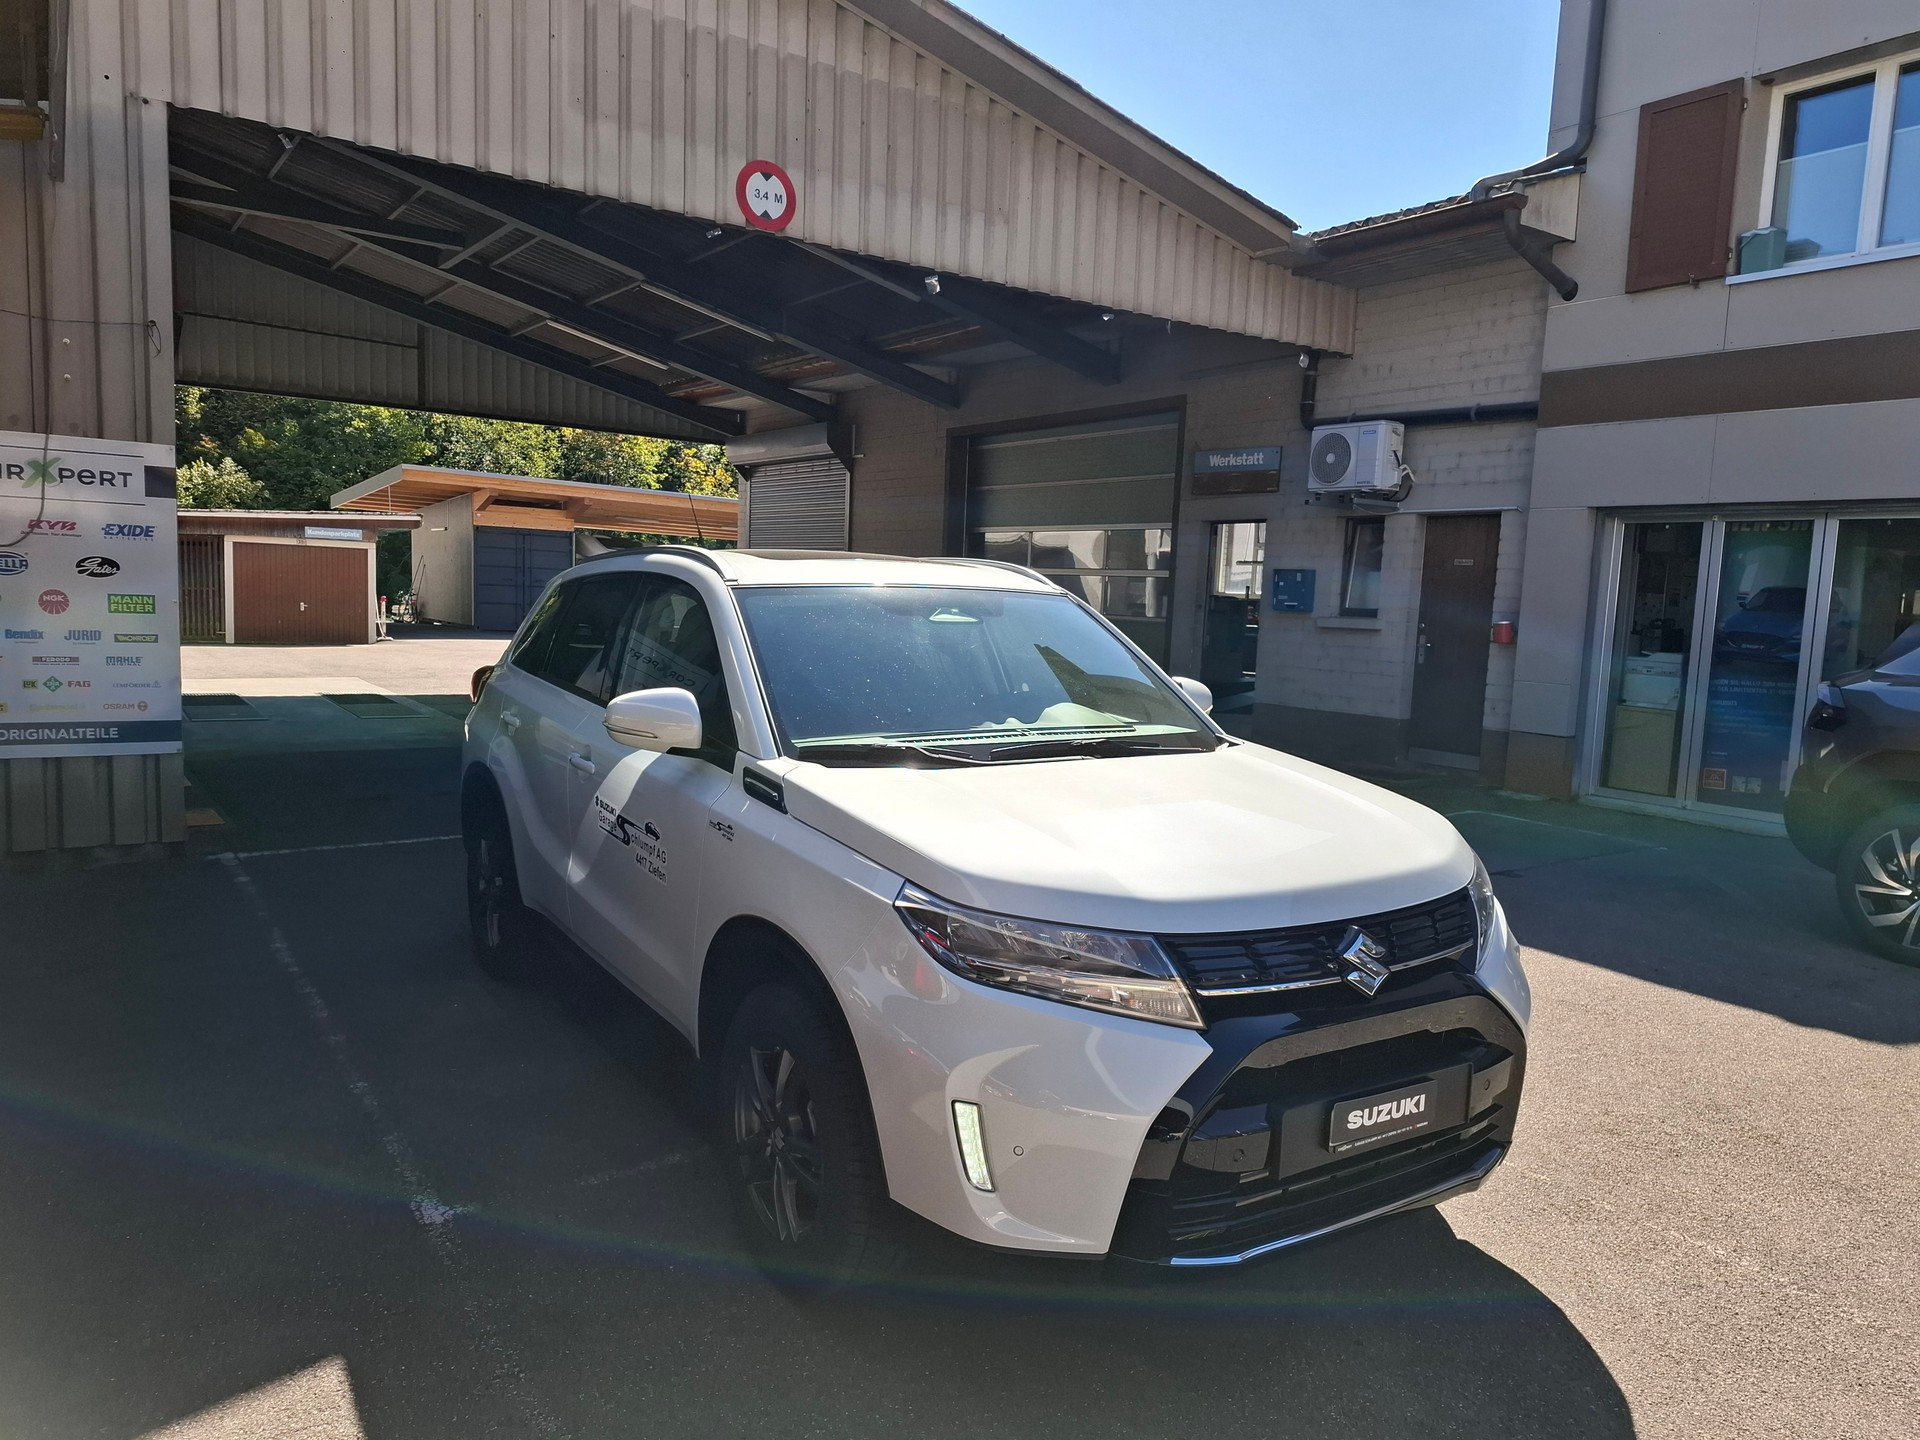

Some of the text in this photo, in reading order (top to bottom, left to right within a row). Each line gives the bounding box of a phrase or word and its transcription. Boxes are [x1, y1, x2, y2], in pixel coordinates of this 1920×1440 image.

[754, 188, 782, 204] 3,4 M
[1209, 452, 1265, 467] Werkstatt
[27, 519, 77, 531] KYB
[102, 523, 155, 538] EXIDE
[307, 528, 360, 538] Kundenparkplatz
[81, 557, 118, 574] Gates
[43, 594, 65, 602] NGK
[110, 595, 153, 604] MANN
[110, 604, 153, 612] FILTER
[4, 629, 44, 640] Bendix
[64, 630, 102, 640] JURID
[106, 656, 143, 664] MAHLE
[67, 680, 91, 688] FAG
[599, 799, 617, 818] SUZUKI
[598, 810, 617, 833] Garage
[656, 847, 667, 864] AG
[648, 860, 667, 884] Ziefen
[1347, 1093, 1426, 1130] SUZUKI
